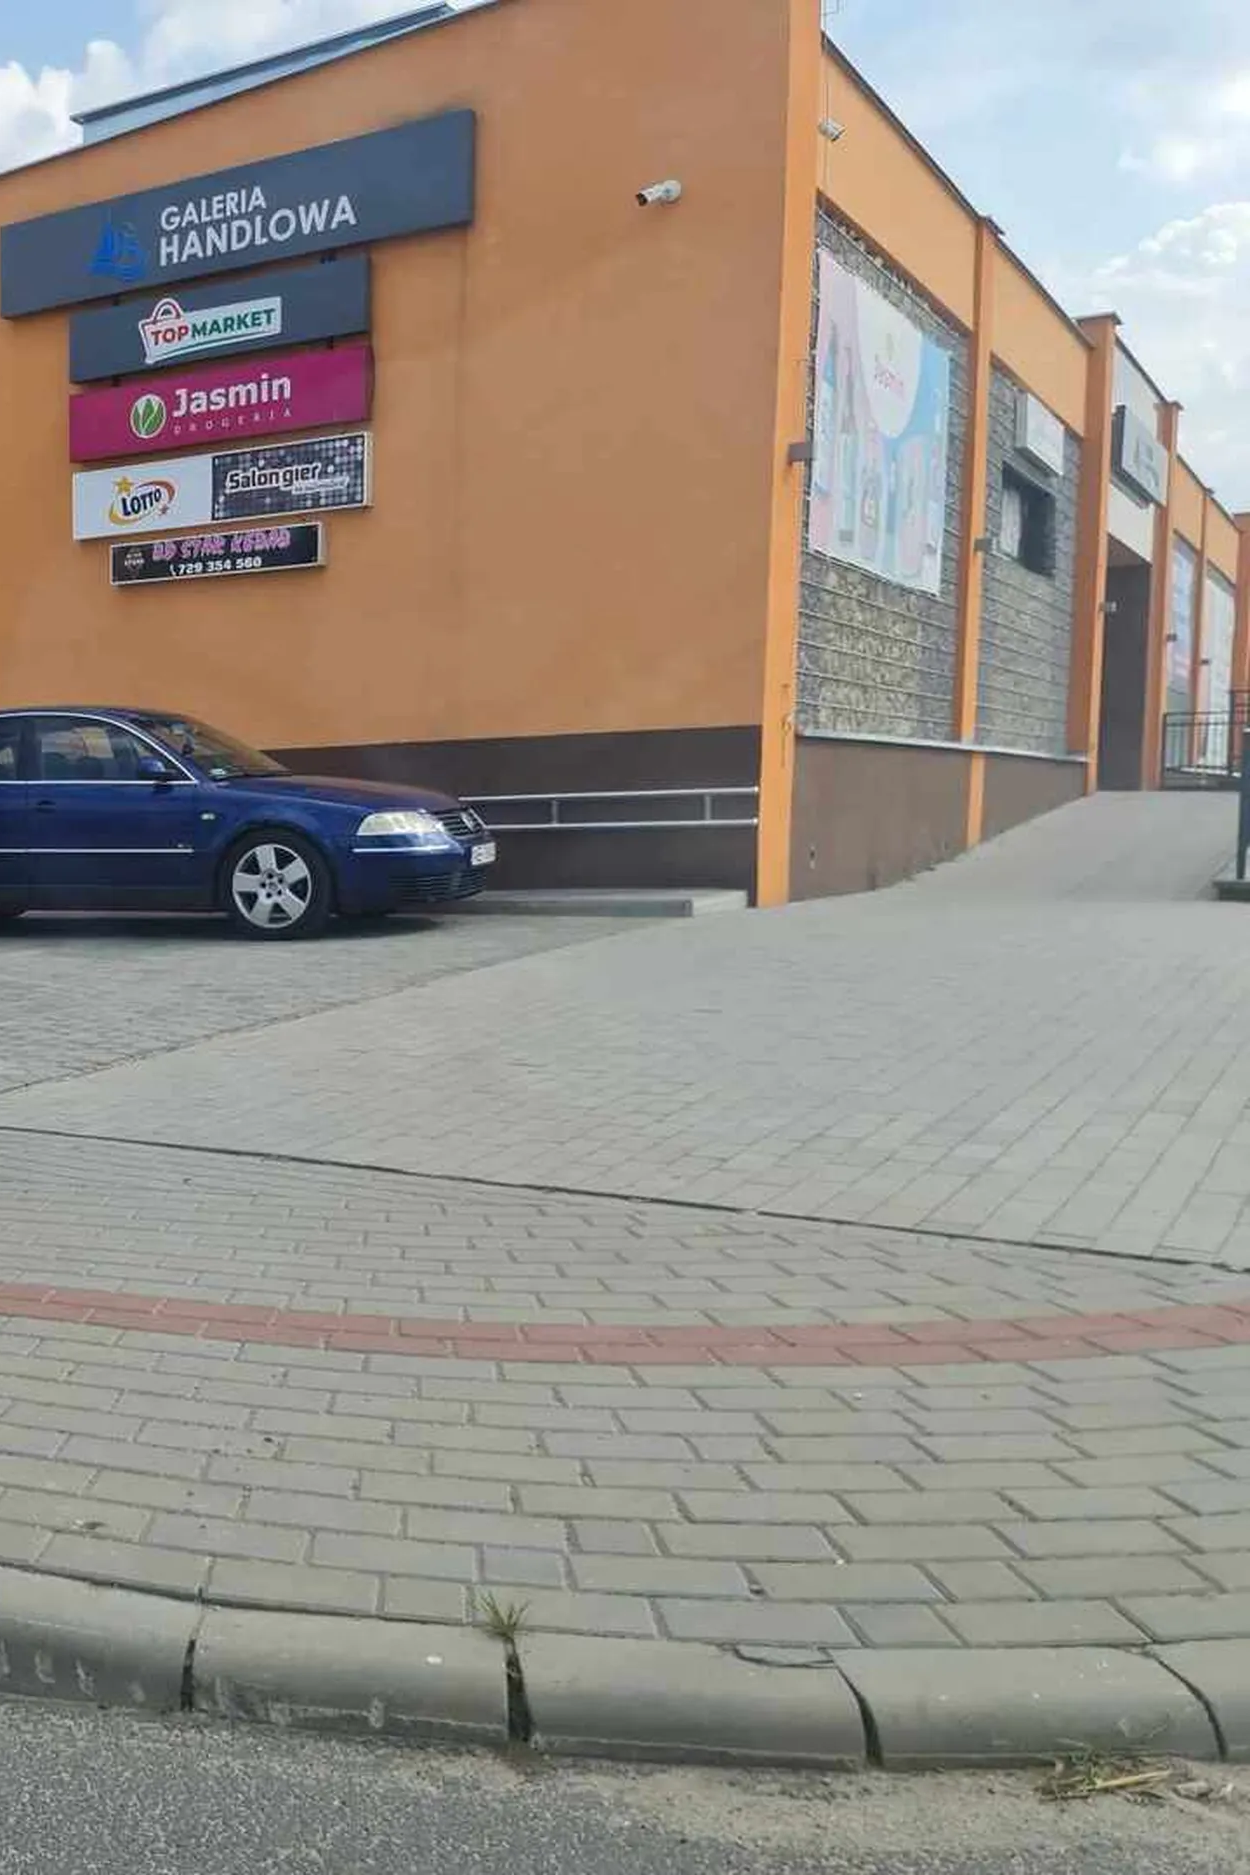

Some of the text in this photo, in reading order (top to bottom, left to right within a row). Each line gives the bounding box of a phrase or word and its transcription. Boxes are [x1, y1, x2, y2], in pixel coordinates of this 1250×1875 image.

[161, 187, 267, 231] GALERIA
[159, 196, 357, 267] HANDLOWA
[150, 308, 276, 346] TOPMARKET
[172, 373, 291, 417] Jasmin
[227, 468, 280, 491] Salon
